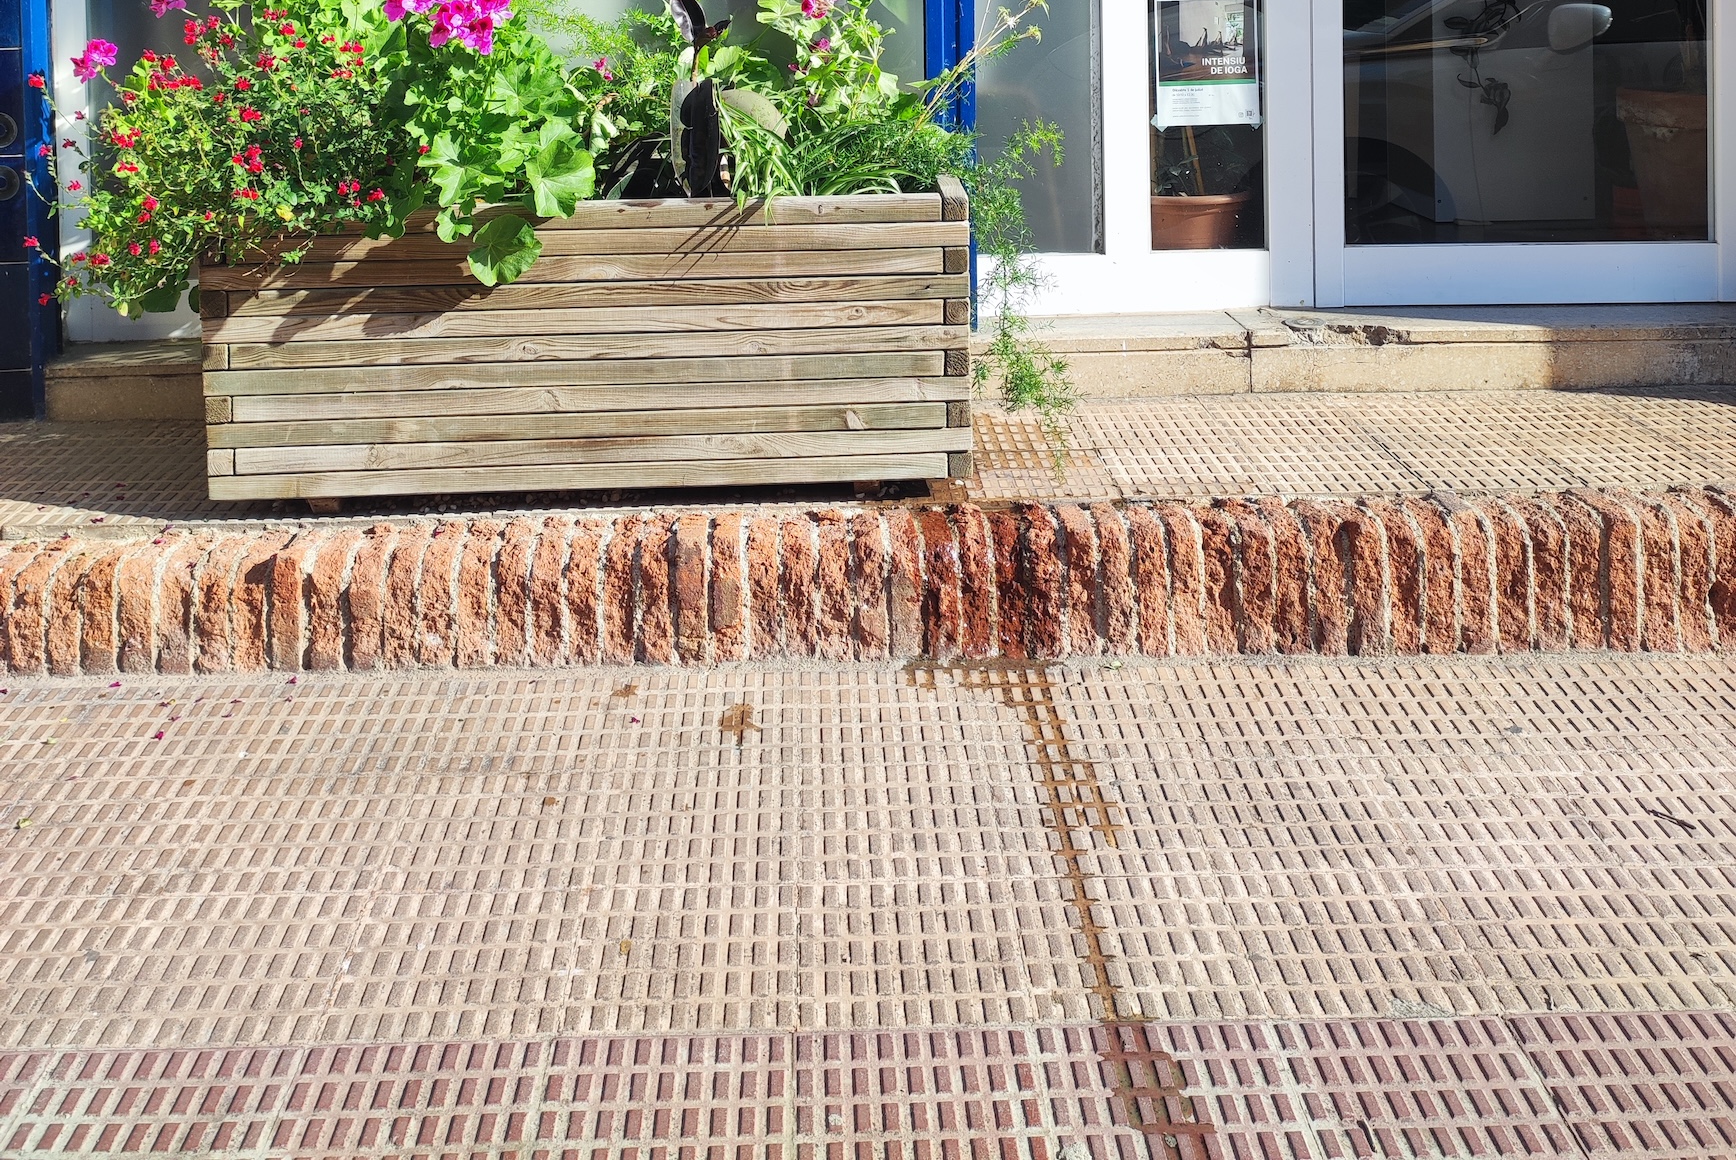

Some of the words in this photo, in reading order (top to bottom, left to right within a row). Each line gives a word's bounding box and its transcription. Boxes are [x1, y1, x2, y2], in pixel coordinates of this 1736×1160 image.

[1201, 56, 1246, 66] INTENSIU
[1210, 66, 1223, 75] DE
[1224, 65, 1248, 75] IOGA
